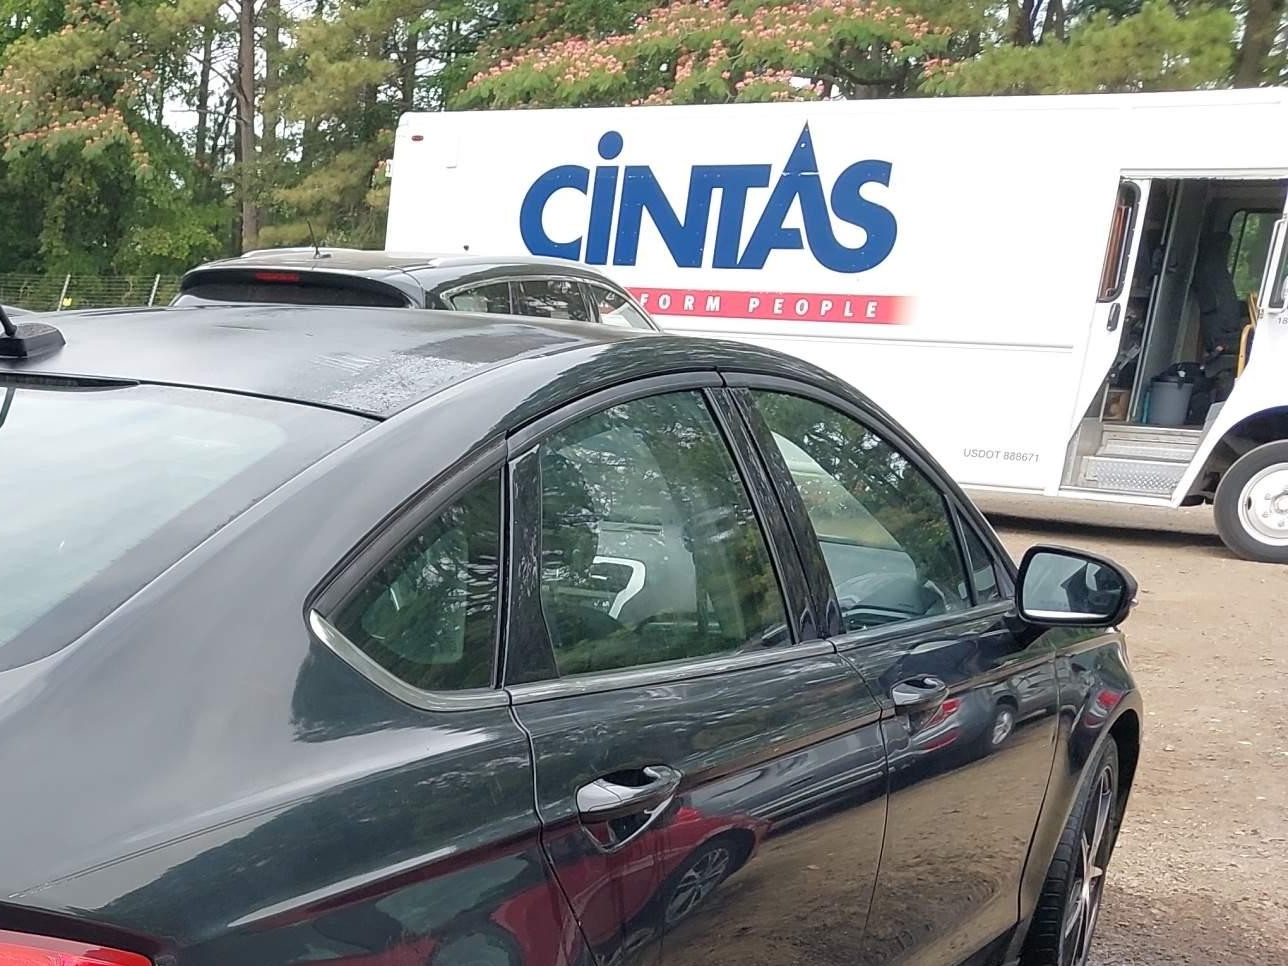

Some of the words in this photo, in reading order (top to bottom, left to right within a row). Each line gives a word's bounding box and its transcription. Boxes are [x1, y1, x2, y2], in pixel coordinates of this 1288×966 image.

[748, 297, 879, 318] PEOPLE
[963, 448, 1001, 460] USDOT
[1003, 451, 1040, 463] 888671
